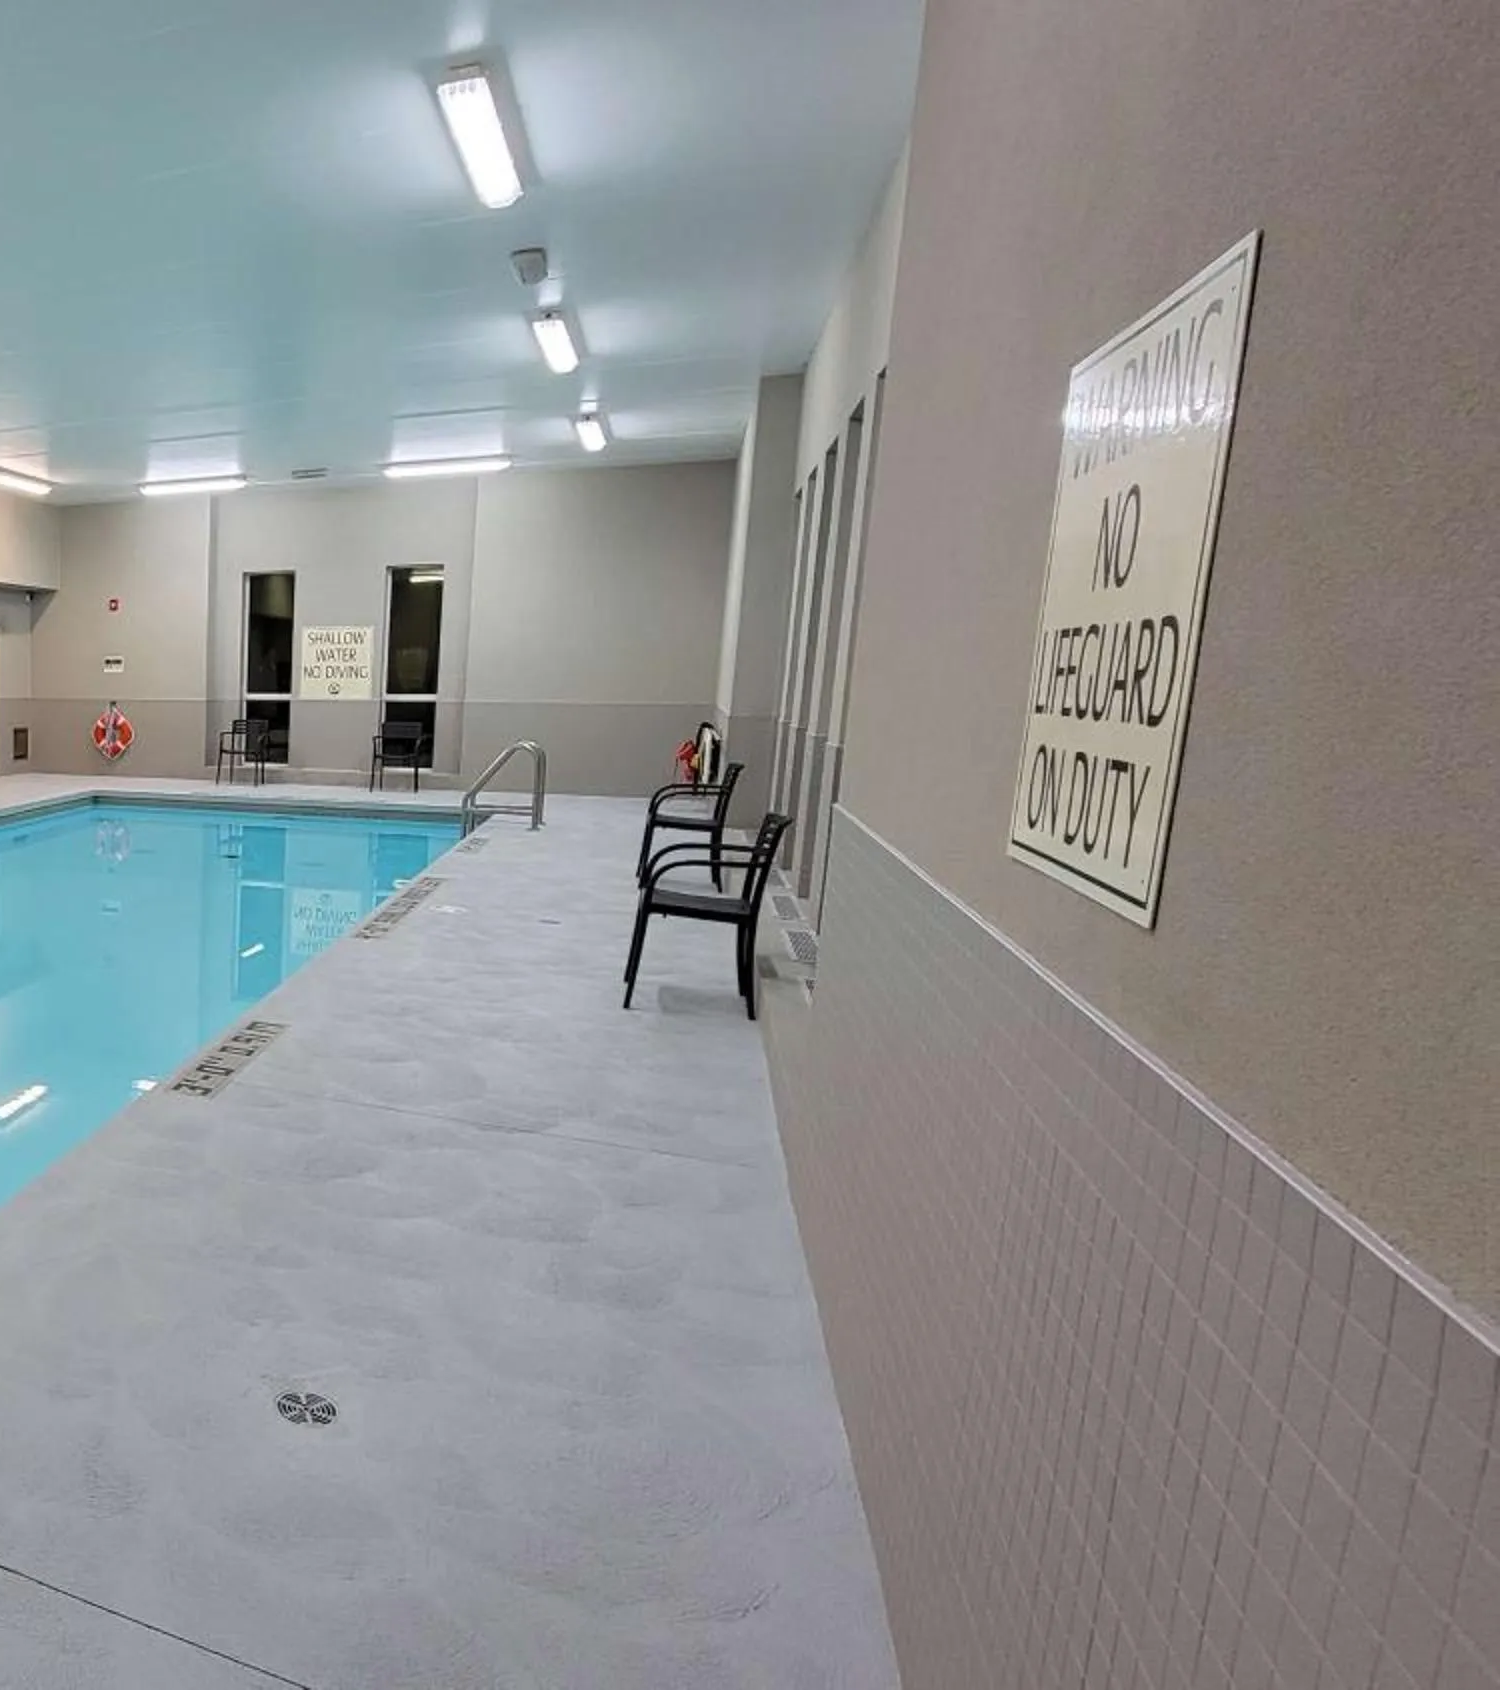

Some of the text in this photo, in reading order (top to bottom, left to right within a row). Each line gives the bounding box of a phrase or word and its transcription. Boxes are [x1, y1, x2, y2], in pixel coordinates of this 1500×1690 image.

[1073, 298, 1225, 479] WARNING
[1092, 483, 1142, 592] NO
[303, 665, 369, 679] NO DIVING
[308, 631, 367, 645] SHALLOW
[315, 648, 357, 662] WATER
[1035, 615, 1180, 727] LIFEGUARD
[1027, 744, 1151, 869] ON DUTY
